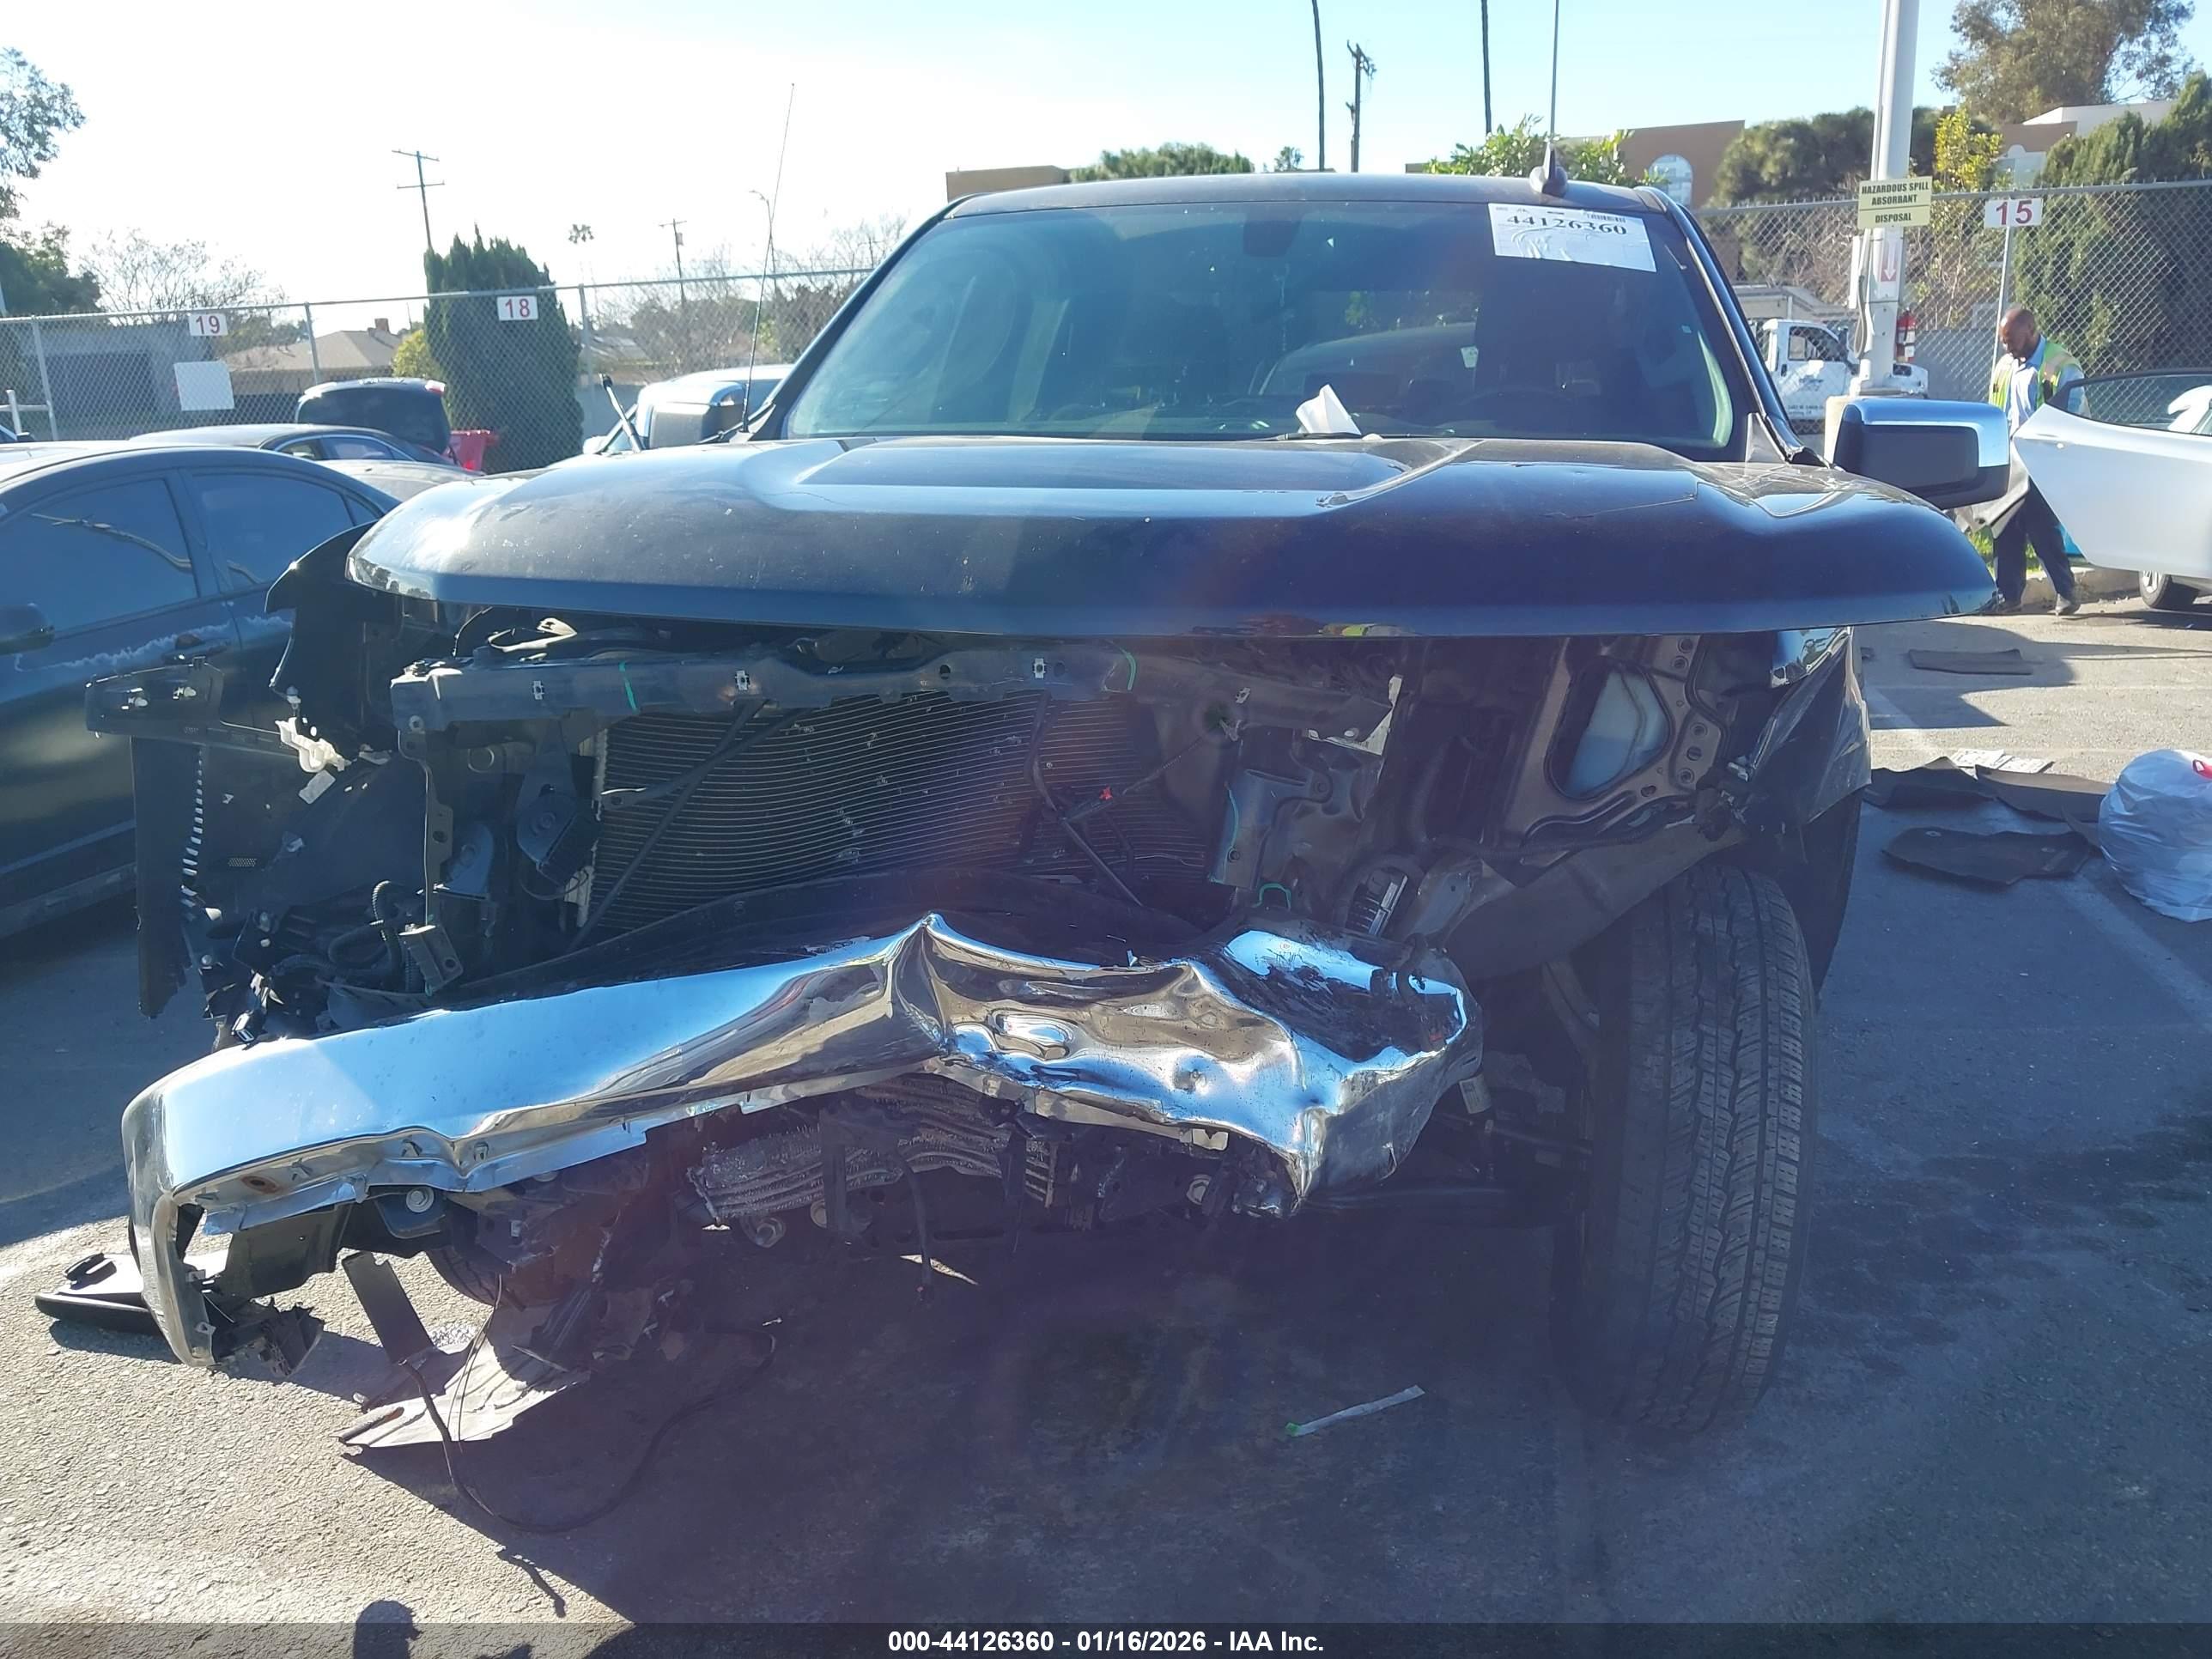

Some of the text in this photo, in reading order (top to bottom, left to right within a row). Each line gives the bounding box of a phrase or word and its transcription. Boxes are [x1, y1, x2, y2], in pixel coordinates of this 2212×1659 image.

[1862, 181, 1929, 194] HAZARDOUS SPILL
[1871, 194, 1917, 205] ABSORBANT
[1875, 212, 1911, 223] DISPOSAL
[1996, 199, 2033, 225] 15
[1507, 215, 1627, 234] 44126360
[505, 298, 530, 318] 18
[196, 315, 220, 334] 19
